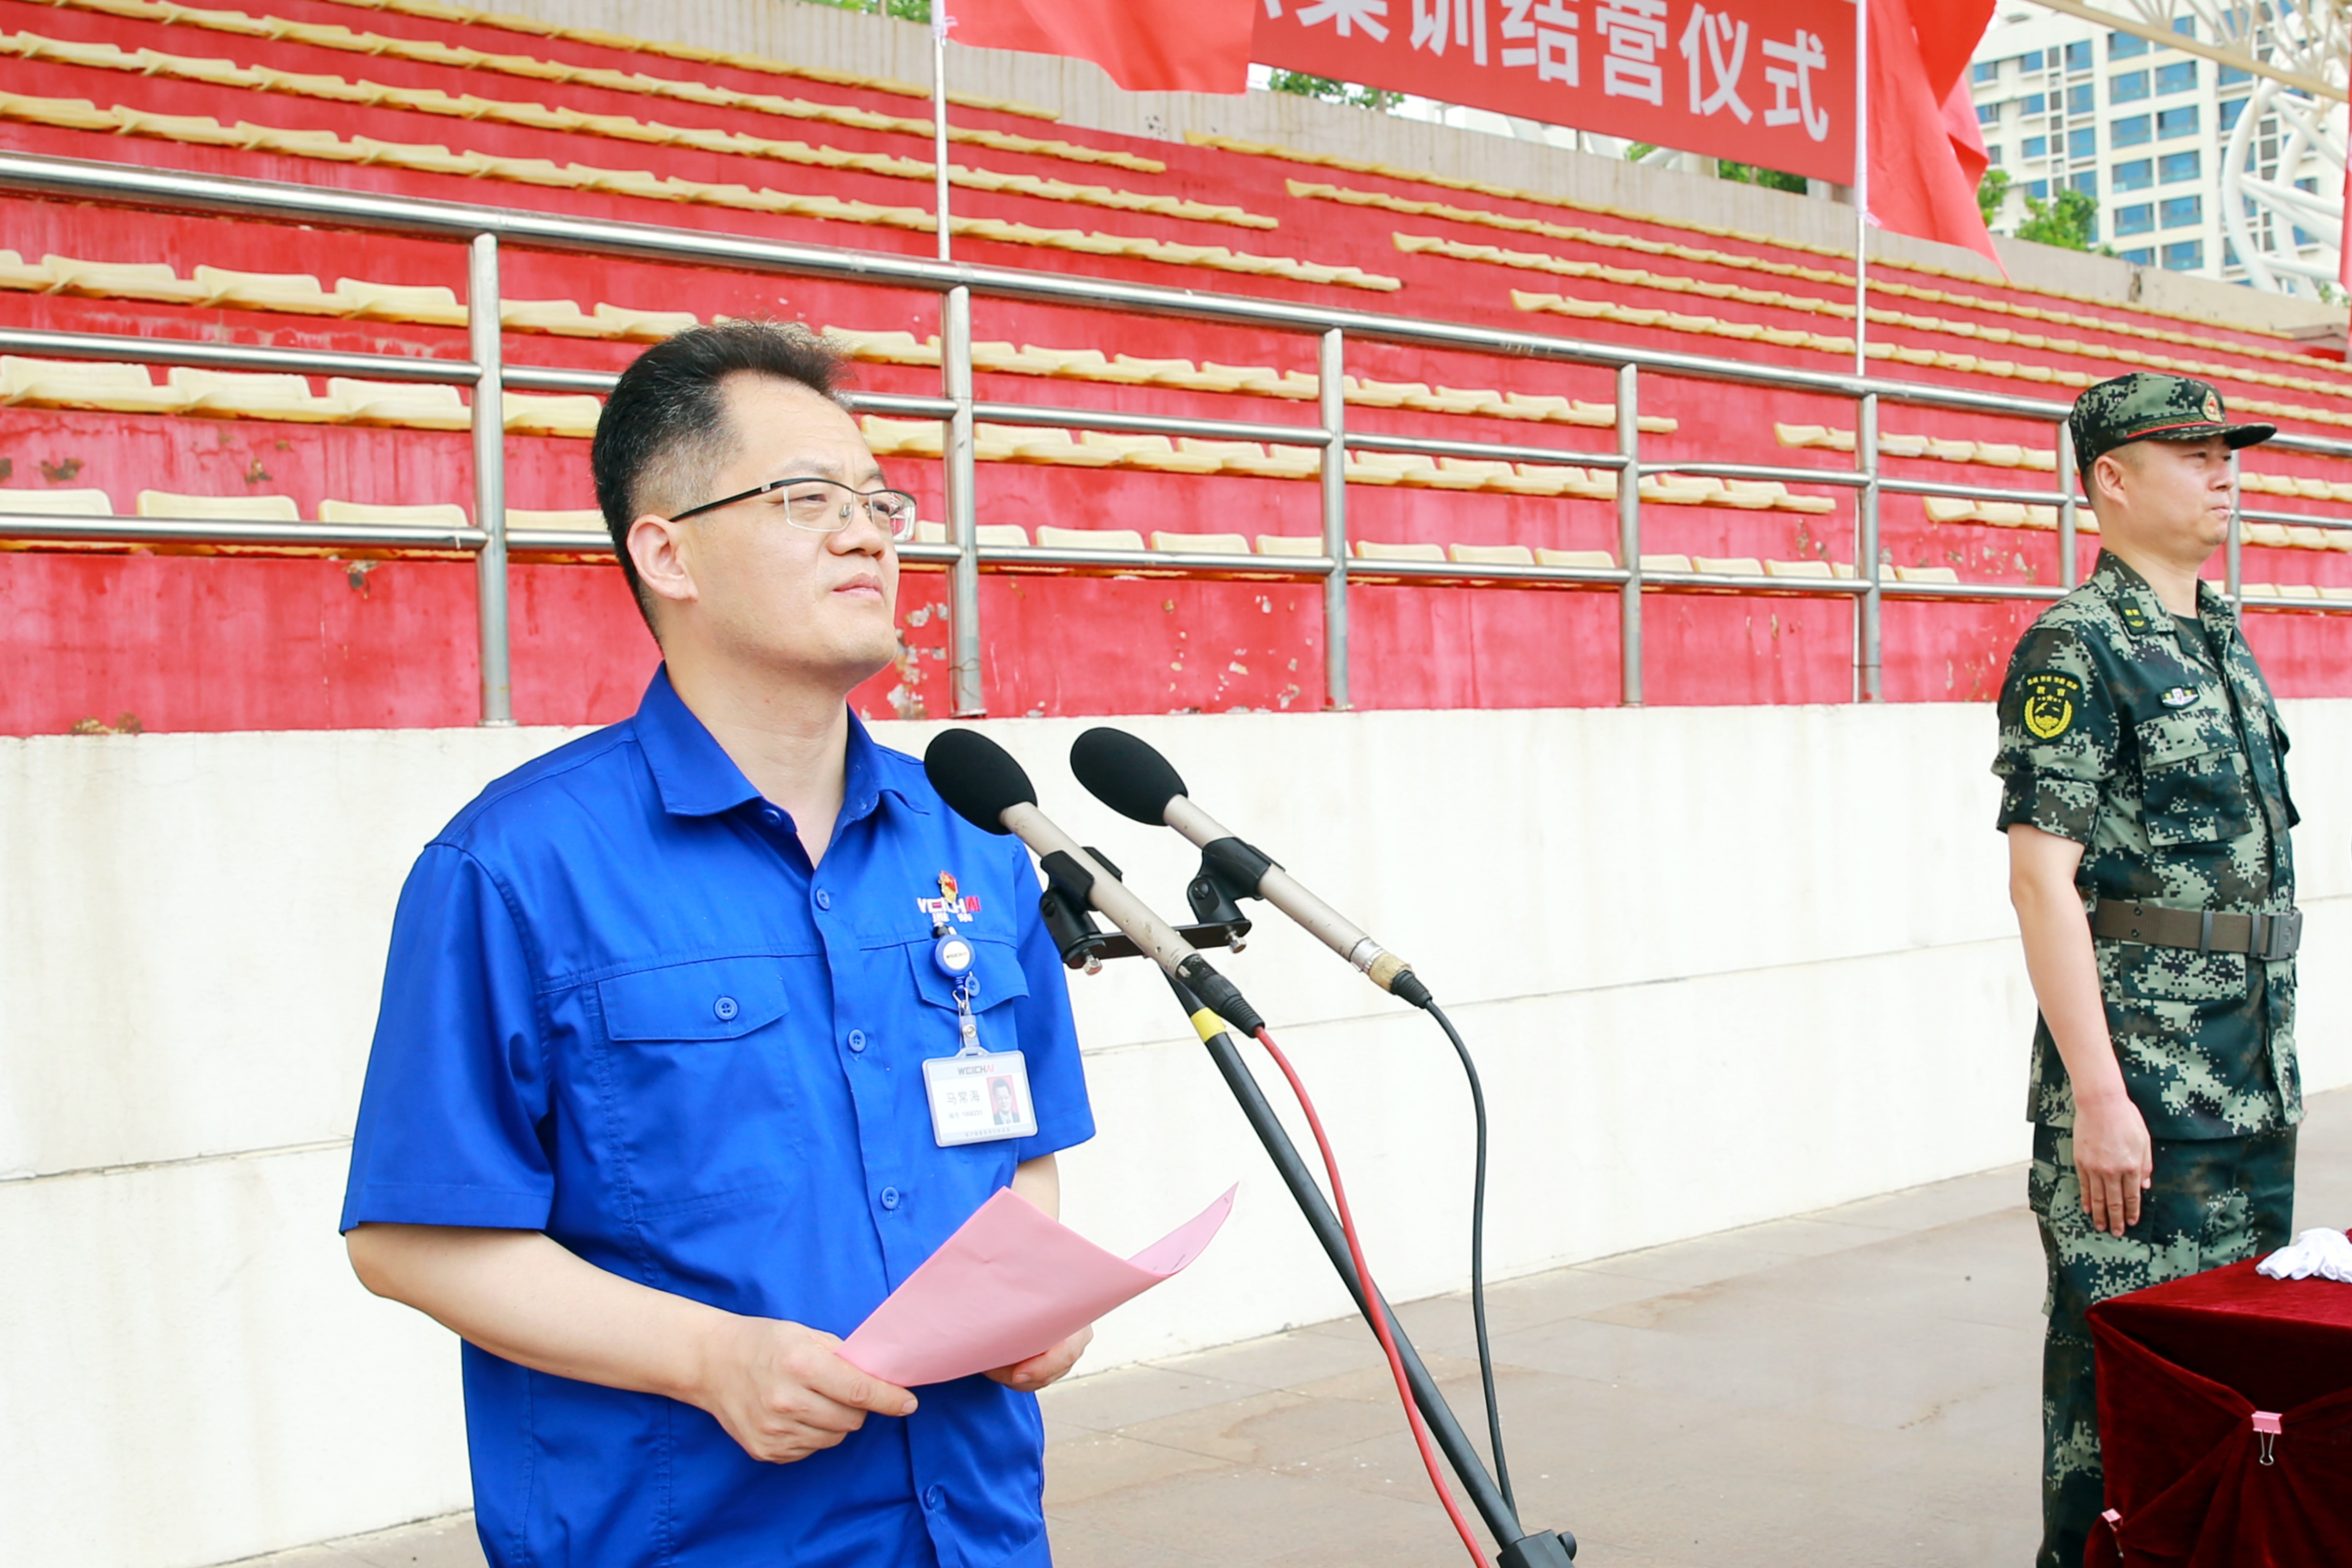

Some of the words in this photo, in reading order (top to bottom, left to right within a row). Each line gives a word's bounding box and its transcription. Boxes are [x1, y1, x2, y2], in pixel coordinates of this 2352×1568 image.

[1264, 0, 1829, 142] 训结营仪式
[958, 1064, 994, 1075] WEICHAI
